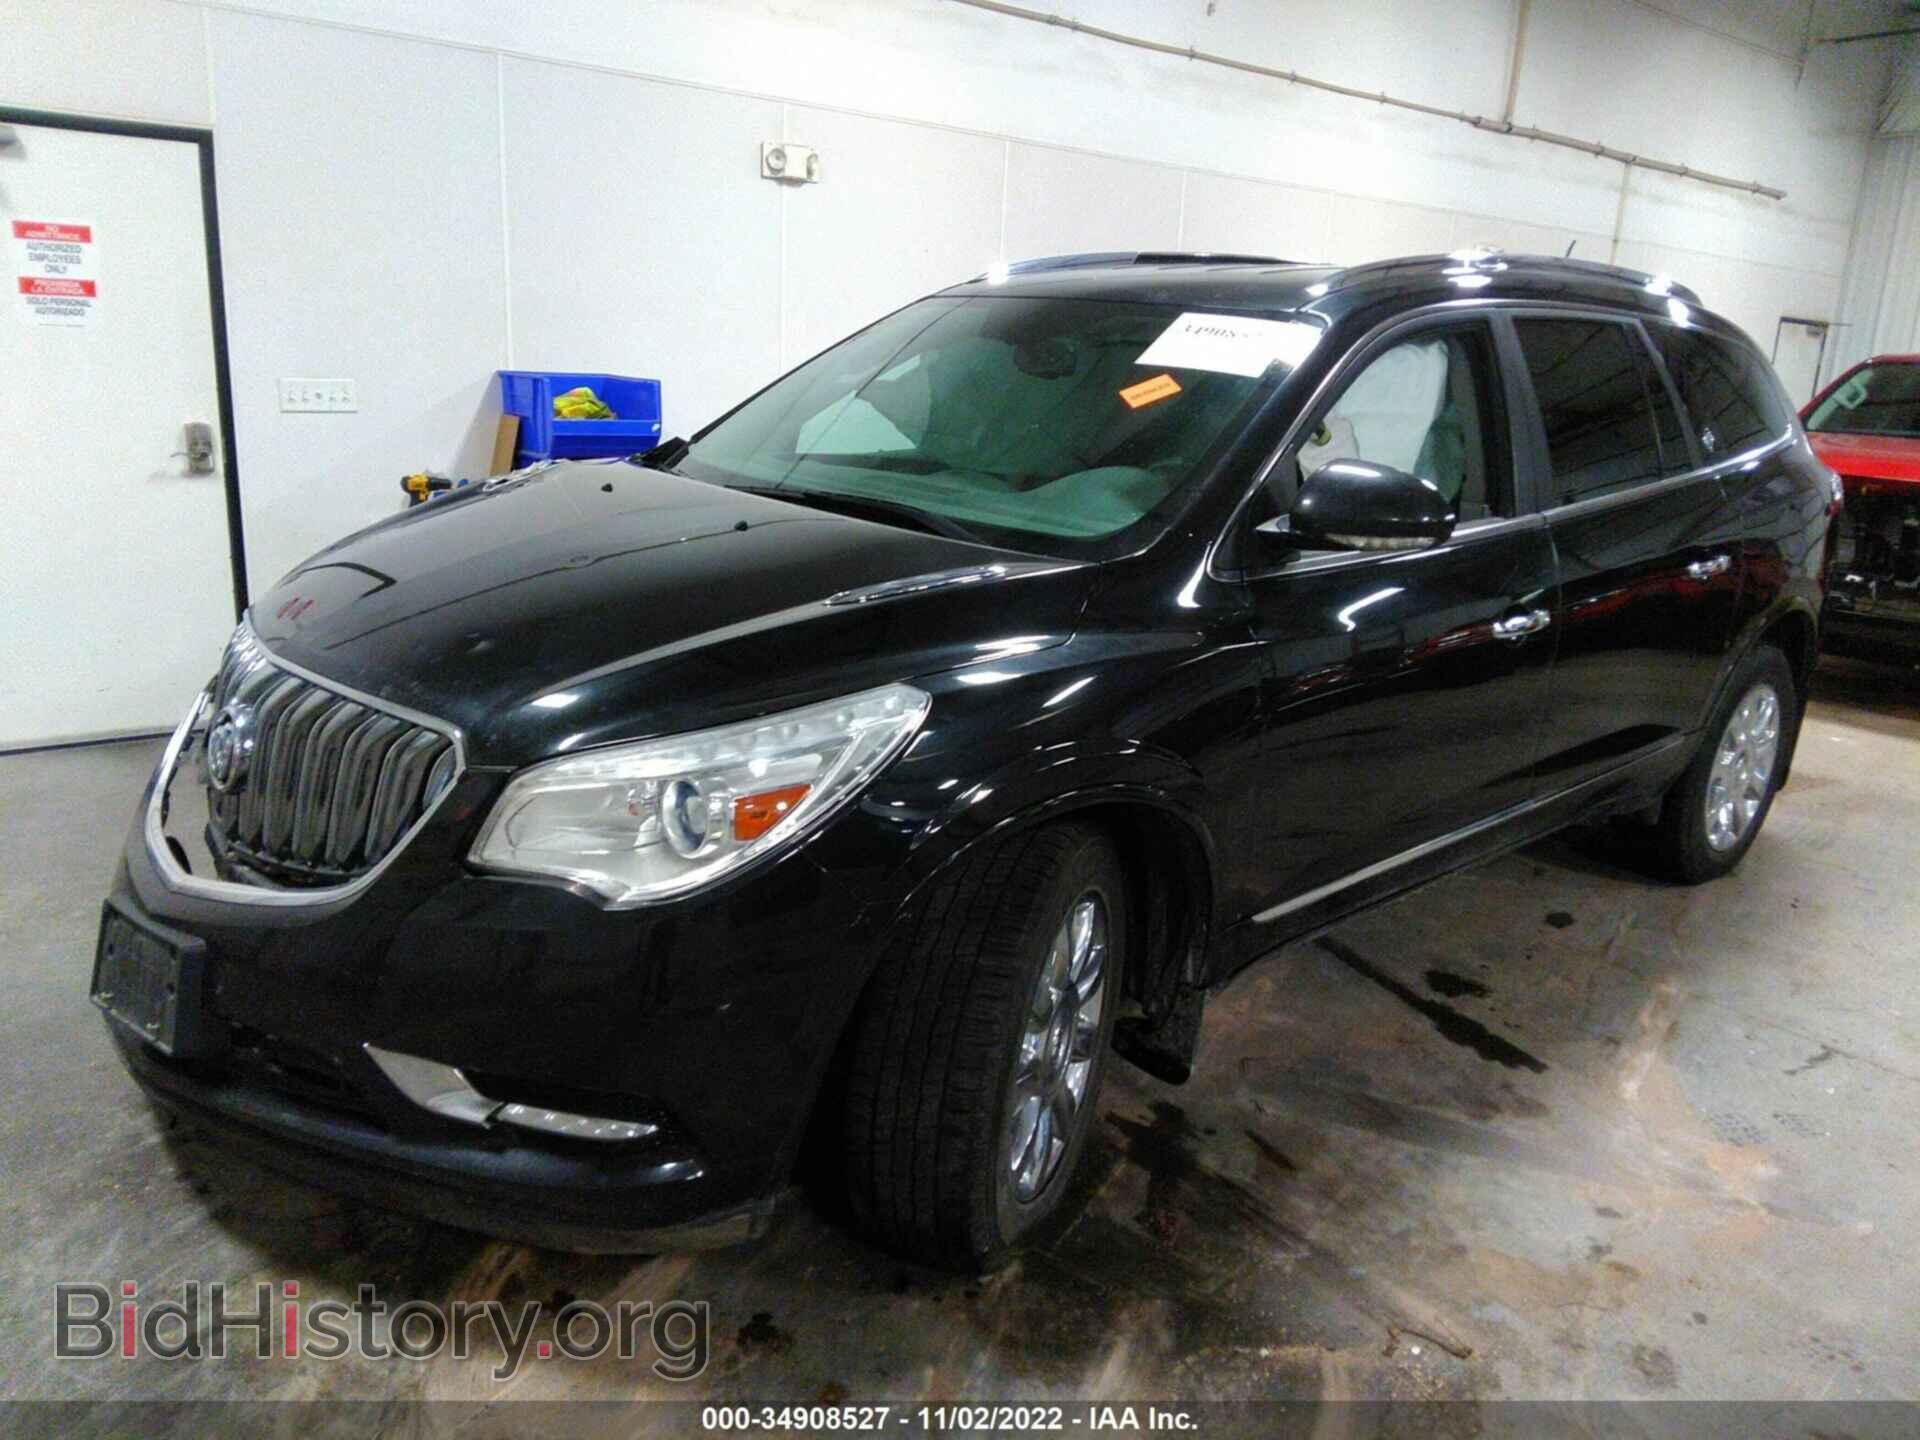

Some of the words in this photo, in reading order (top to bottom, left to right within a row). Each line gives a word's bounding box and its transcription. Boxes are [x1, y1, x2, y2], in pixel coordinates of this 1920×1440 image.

[26, 242, 82, 253] AUTHORIZED
[28, 252, 82, 264] EMPLOYEES
[50, 298, 92, 308] PERSONAL
[35, 306, 86, 316] AUTORIZADO
